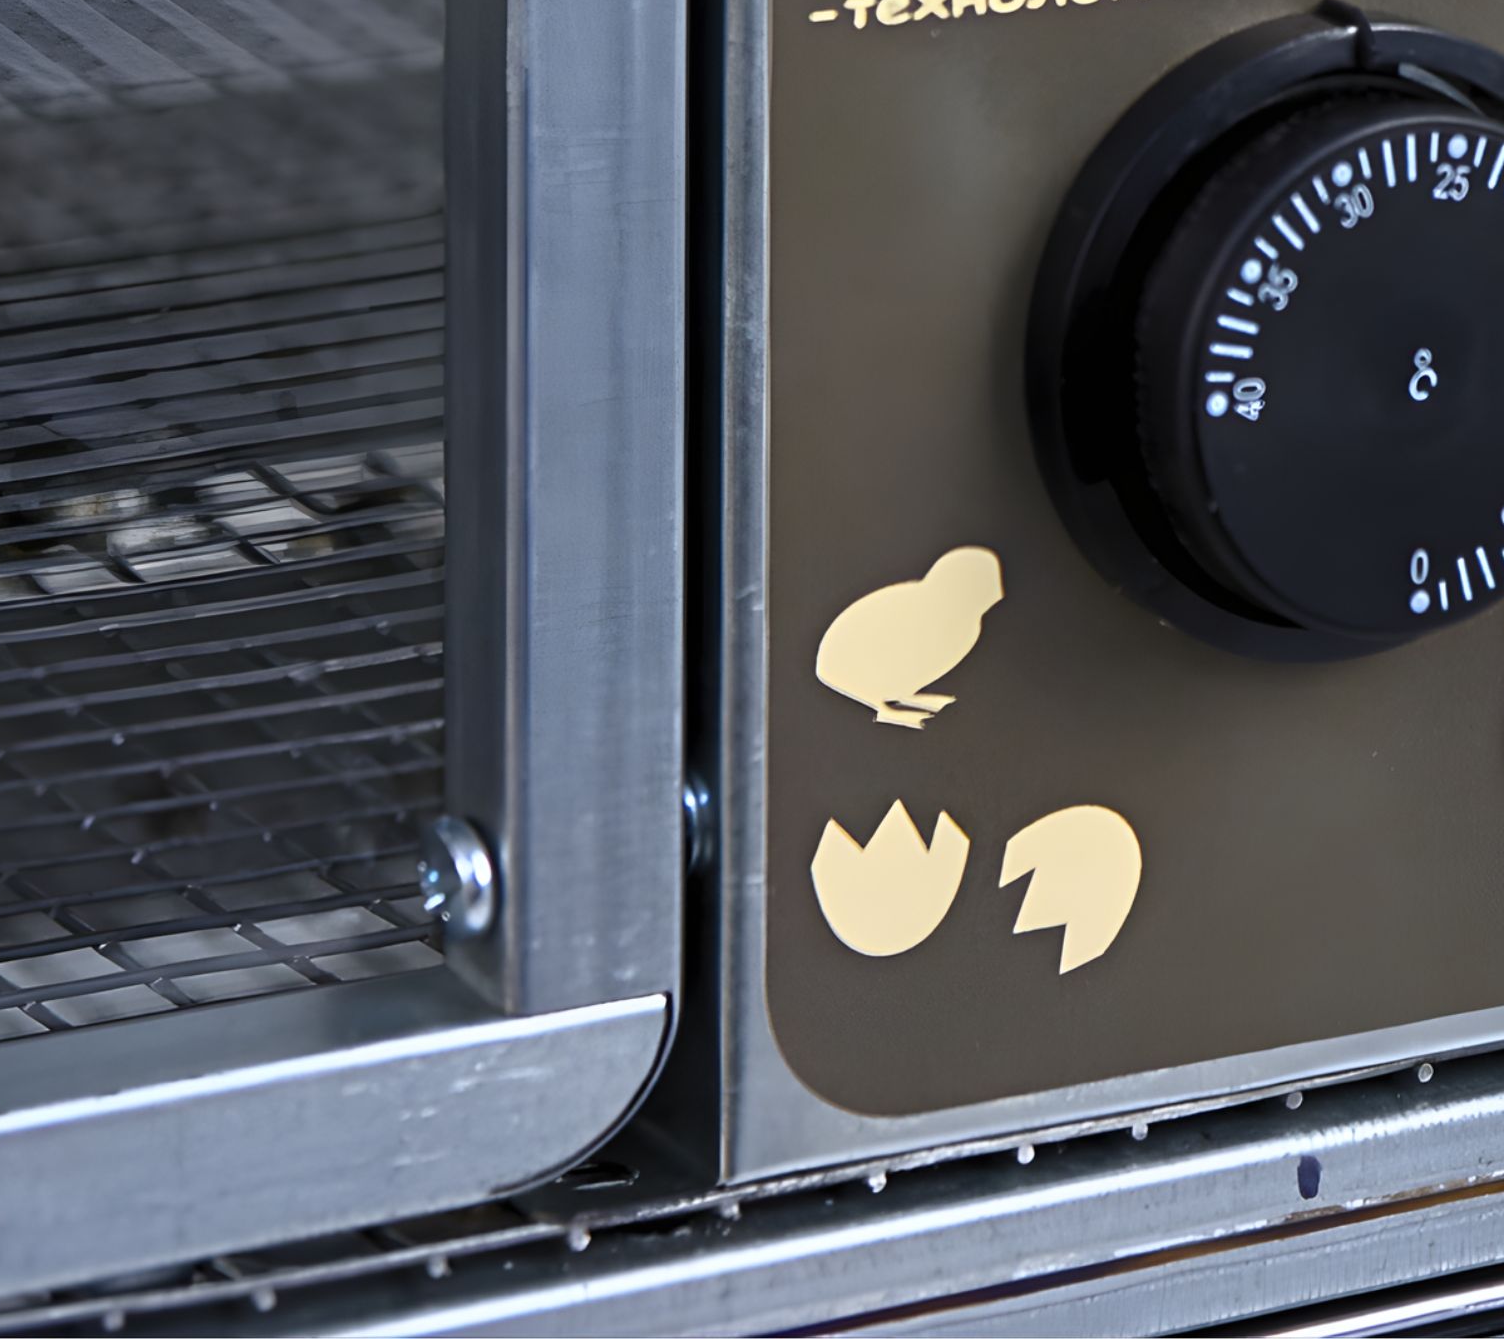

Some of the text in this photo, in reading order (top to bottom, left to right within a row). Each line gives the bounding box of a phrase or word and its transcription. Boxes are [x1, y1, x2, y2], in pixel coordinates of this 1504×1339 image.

[1432, 163, 1470, 202] 25
[1334, 185, 1374, 228] 30
[1257, 264, 1298, 310] 35
[1231, 376, 1266, 421] 40
[1411, 549, 1428, 585] 0
